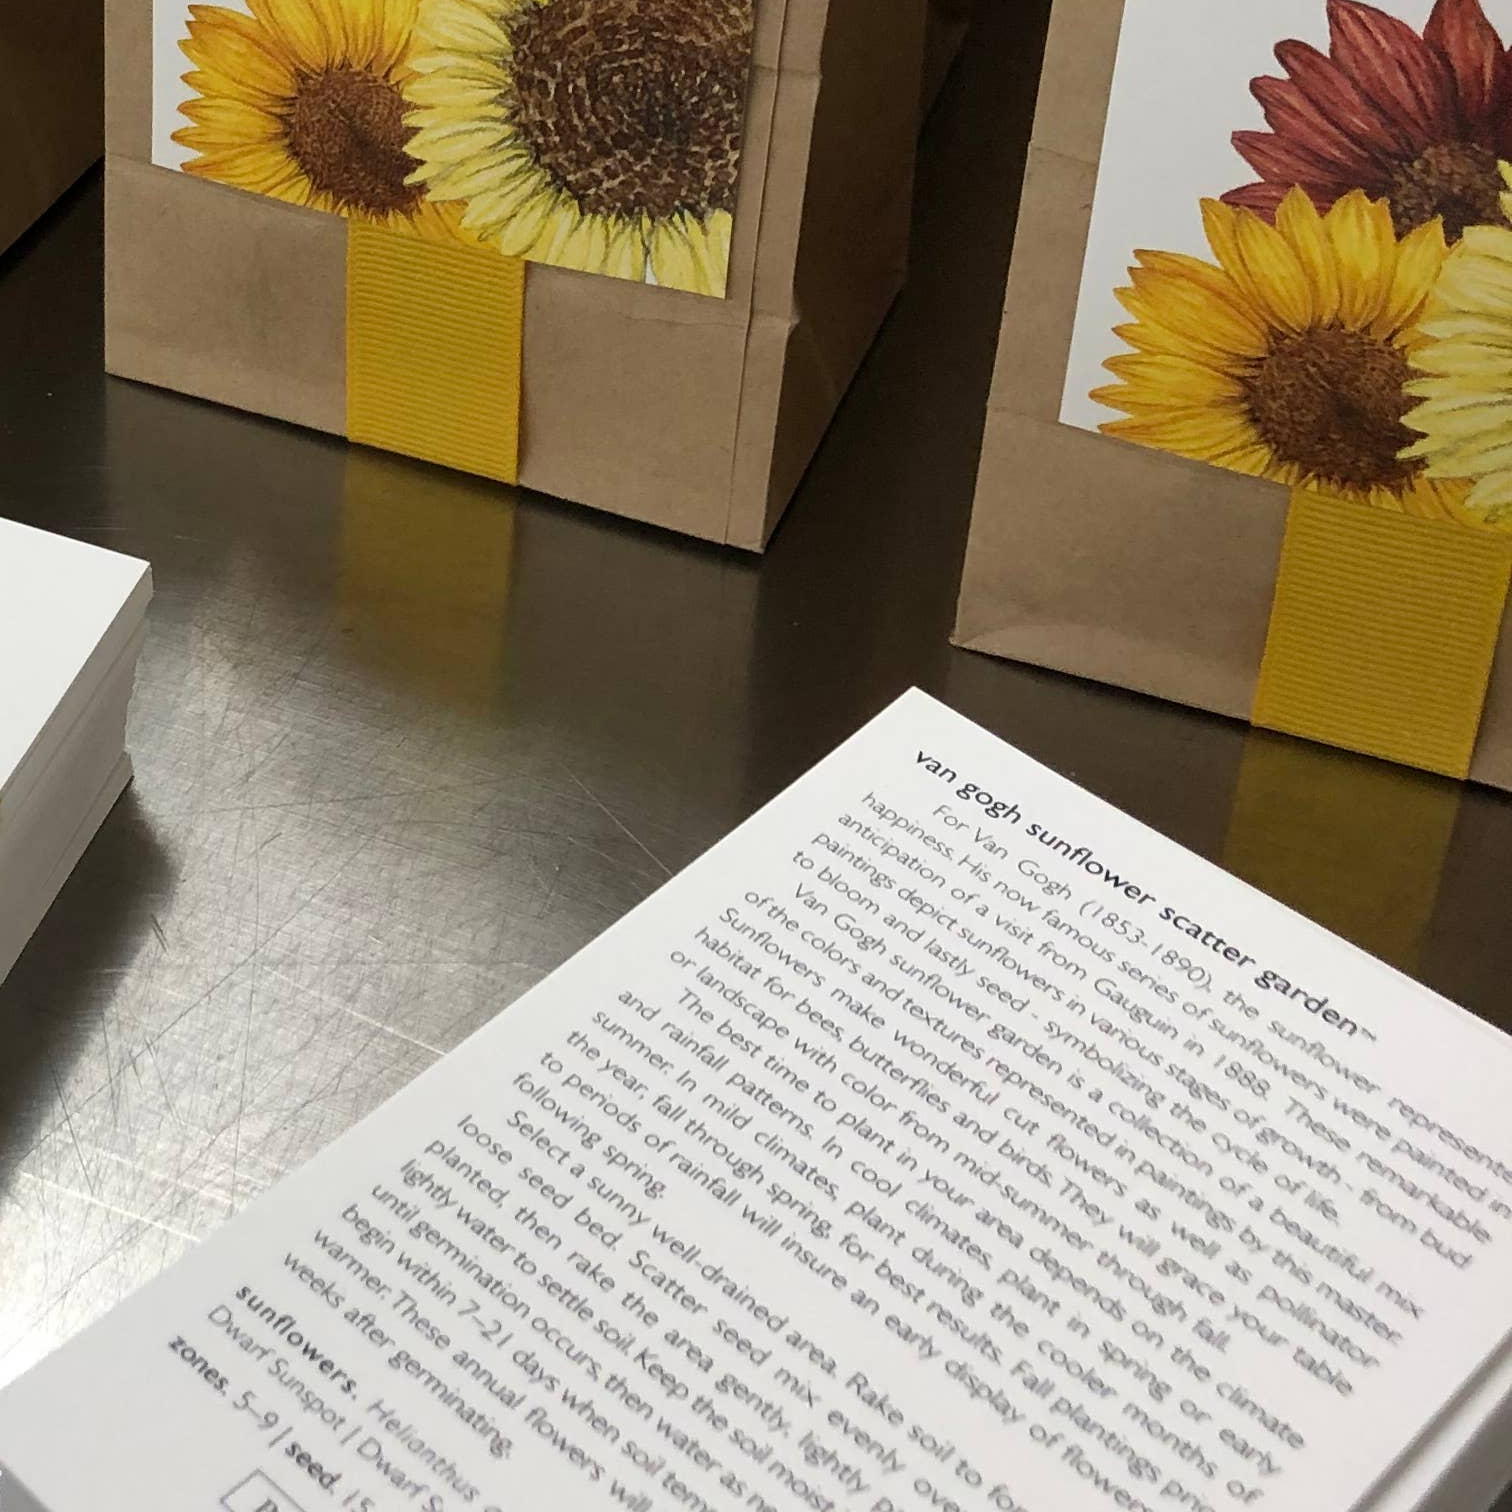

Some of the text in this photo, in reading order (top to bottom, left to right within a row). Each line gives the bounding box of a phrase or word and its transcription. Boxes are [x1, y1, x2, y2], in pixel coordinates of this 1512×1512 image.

[811, 833, 1163, 1066] paintings depict sunflowers in various
[838, 814, 1178, 1039] anticipation of a visit from Gauguin
[916, 750, 957, 783] van
[955, 782, 1021, 824] gogh
[1025, 823, 1155, 903] sunflower
[1158, 907, 1255, 966] scatter
[932, 804, 969, 830] For
[973, 826, 1008, 859] Van
[1017, 859, 1071, 900] Gogh
[957, 853, 991, 882] His
[992, 880, 1040, 912] now
[1041, 909, 1115, 962] famous
[1117, 960, 1178, 1003] series
[669, 950, 949, 1153] or landscape with color from
[694, 926, 761, 979] habitat
[762, 975, 795, 1000] for
[848, 1035, 949, 1112] butterflies
[952, 1112, 998, 1144] and
[719, 907, 1039, 1136] Sunflowers make wonderful cut
[744, 891, 1116, 1146] of the colors and textures represented
[792, 850, 1165, 1108] to bloom and lastly seed symbolizing
[795, 882, 1062, 1074] Van Gogh sunflower garden
[513, 1072, 601, 1149] following
[539, 1051, 847, 1289] to periods of rainfall will insure
[566, 1030, 600, 1060] the
[651, 1093, 687, 1122] fall
[683, 1119, 764, 1184] through
[838, 1232, 875, 1262] for
[617, 991, 661, 1021] and
[660, 1021, 729, 1071] rainfall
[821, 1135, 843, 1159] In
[850, 1160, 902, 1197] cool
[675, 1069, 697, 1092] In
[701, 1093, 753, 1130] mild
[843, 1200, 905, 1245] plant
[678, 986, 974, 1206] The best time to plant in your
[283, 1252, 344, 1308] weeks
[343, 1307, 395, 1347] after
[371, 1184, 420, 1222] until
[408, 1221, 529, 1317] germination
[604, 1373, 653, 1420] then
[400, 1158, 457, 1208] lightly
[456, 1205, 515, 1252] water
[512, 1251, 537, 1275] to
[536, 1273, 593, 1320] settle
[633, 1347, 689, 1398] Keep
[457, 1114, 512, 1163] loose
[517, 1167, 573, 1209] seed
[628, 1249, 707, 1313] Scatter
[506, 1110, 788, 1332] Select a sunny well-drained
[514, 1206, 561, 1250] then
[566, 1251, 615, 1291] rake
[620, 1291, 658, 1326] the
[663, 1329, 713, 1373] area
[207, 1304, 428, 1497] Dwarf Sunspot Dwarf
[341, 1203, 395, 1254] begin
[396, 1251, 456, 1305] within
[512, 1350, 560, 1391] days
[561, 1388, 620, 1443] when
[392, 1290, 450, 1349] These
[452, 1350, 526, 1409] annual
[524, 1407, 604, 1480] flowers
[366, 1399, 479, 1502] Helianthus
